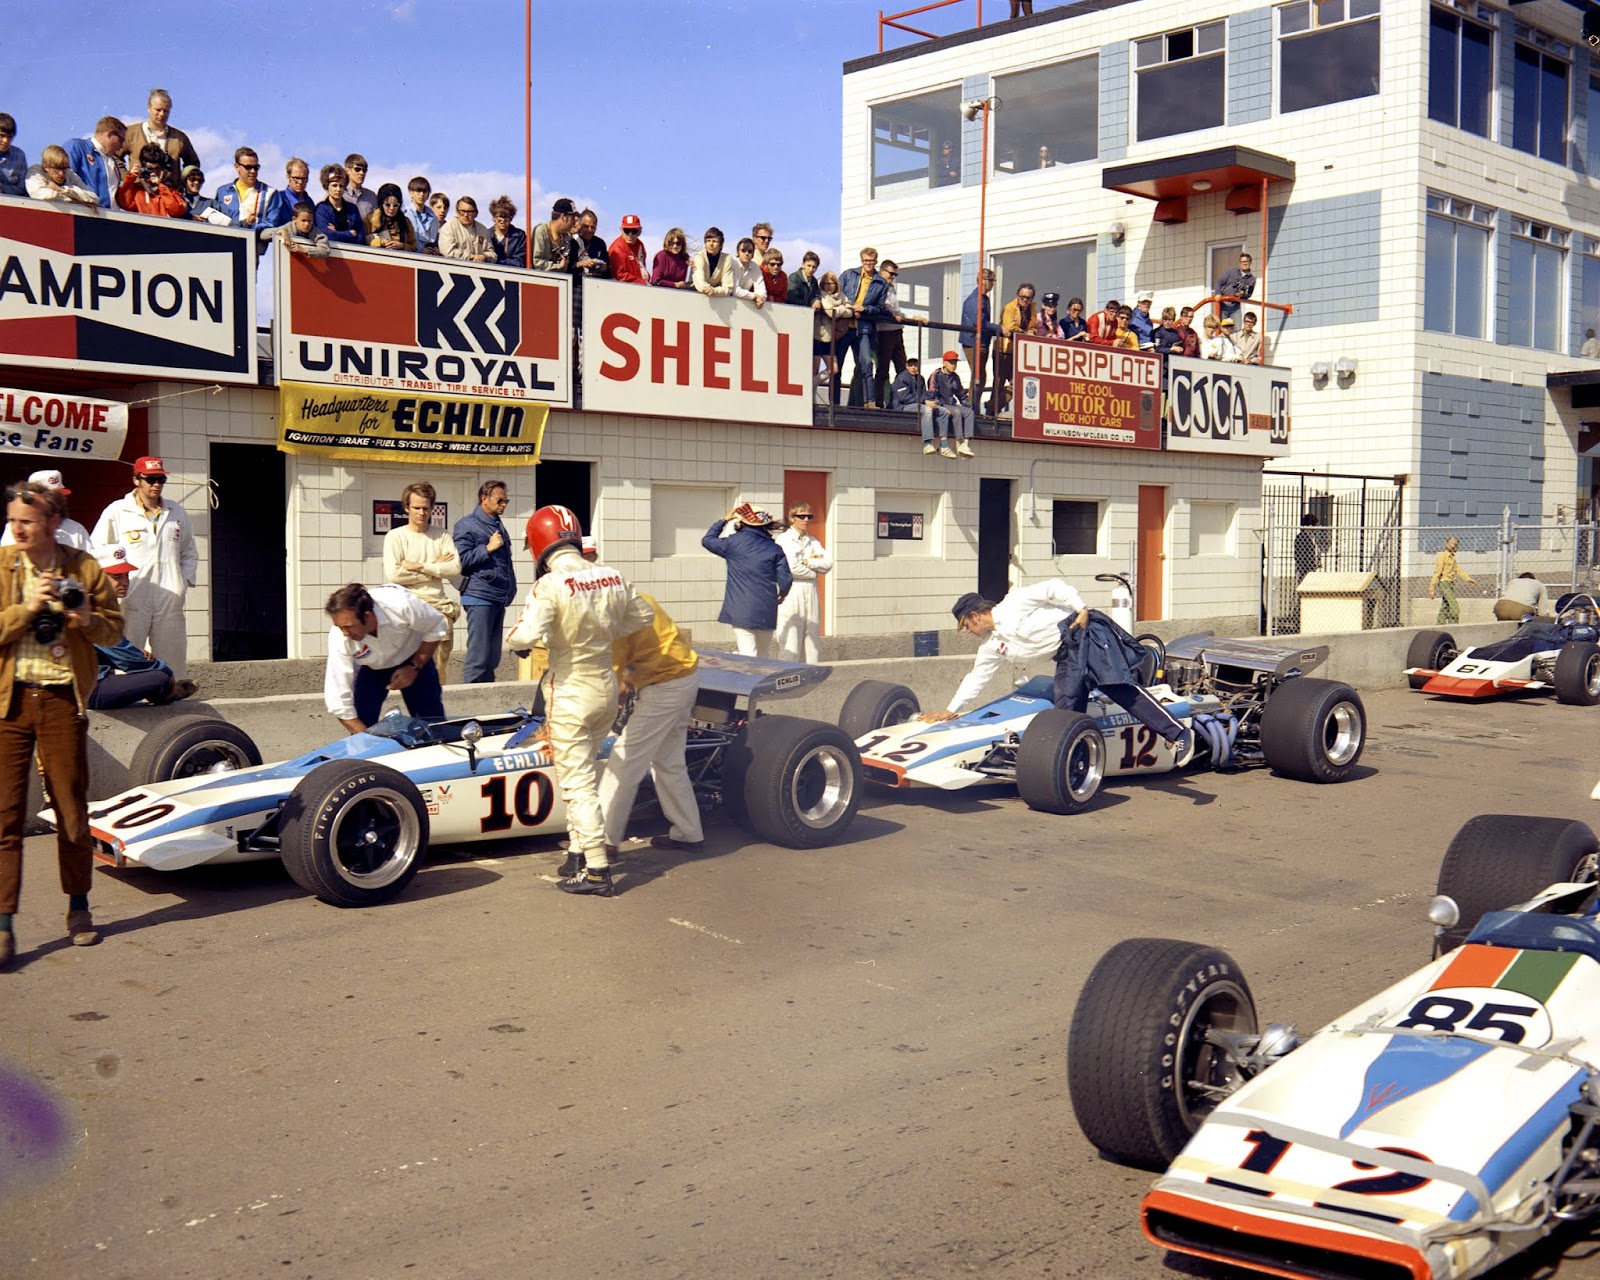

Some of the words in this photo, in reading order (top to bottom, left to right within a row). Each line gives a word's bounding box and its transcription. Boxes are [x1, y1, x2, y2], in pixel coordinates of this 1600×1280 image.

[0, 255, 223, 324] AMPION
[299, 340, 555, 391] UNIROYAL
[599, 312, 804, 396] SHELL
[1023, 343, 1155, 386] LUBRIPLATE
[400, 379, 442, 390] TRANSIT
[446, 383, 468, 393] TIRE
[471, 384, 509, 396] SERVICE
[1069, 381, 1086, 395] THE
[1087, 383, 1115, 398] COOL
[0, 394, 109, 433] LCOME
[301, 395, 390, 422] Headquarters
[1045, 391, 1106, 416] MOTOR
[1110, 398, 1136, 419] OIL
[1173, 374, 1249, 436] CJCA
[1271, 385, 1288, 440] 93
[359, 413, 380, 434] for
[1059, 412, 1076, 424] FOR
[1078, 414, 1097, 425] HOT
[1099, 416, 1122, 428] CARS
[34, 429, 94, 453] Fans
[288, 432, 335, 444] IGNITION
[338, 436, 371, 446] BRAKE
[375, 439, 396, 448] FUEL
[397, 440, 443, 450] SYSTEMS
[449, 443, 472, 452] WIRE
[478, 445, 505, 453] CABLE
[506, 445, 532, 453] PARTS
[564, 575, 621, 597] Firestone
[1456, 664, 1491, 675] 61
[1110, 712, 1140, 727] ECHL
[857, 735, 928, 763] 12
[1119, 725, 1159, 769] 12
[90, 793, 176, 829] 10
[314, 774, 376, 840] Firestone
[480, 770, 554, 833] 10
[1395, 996, 1539, 1044] 85
